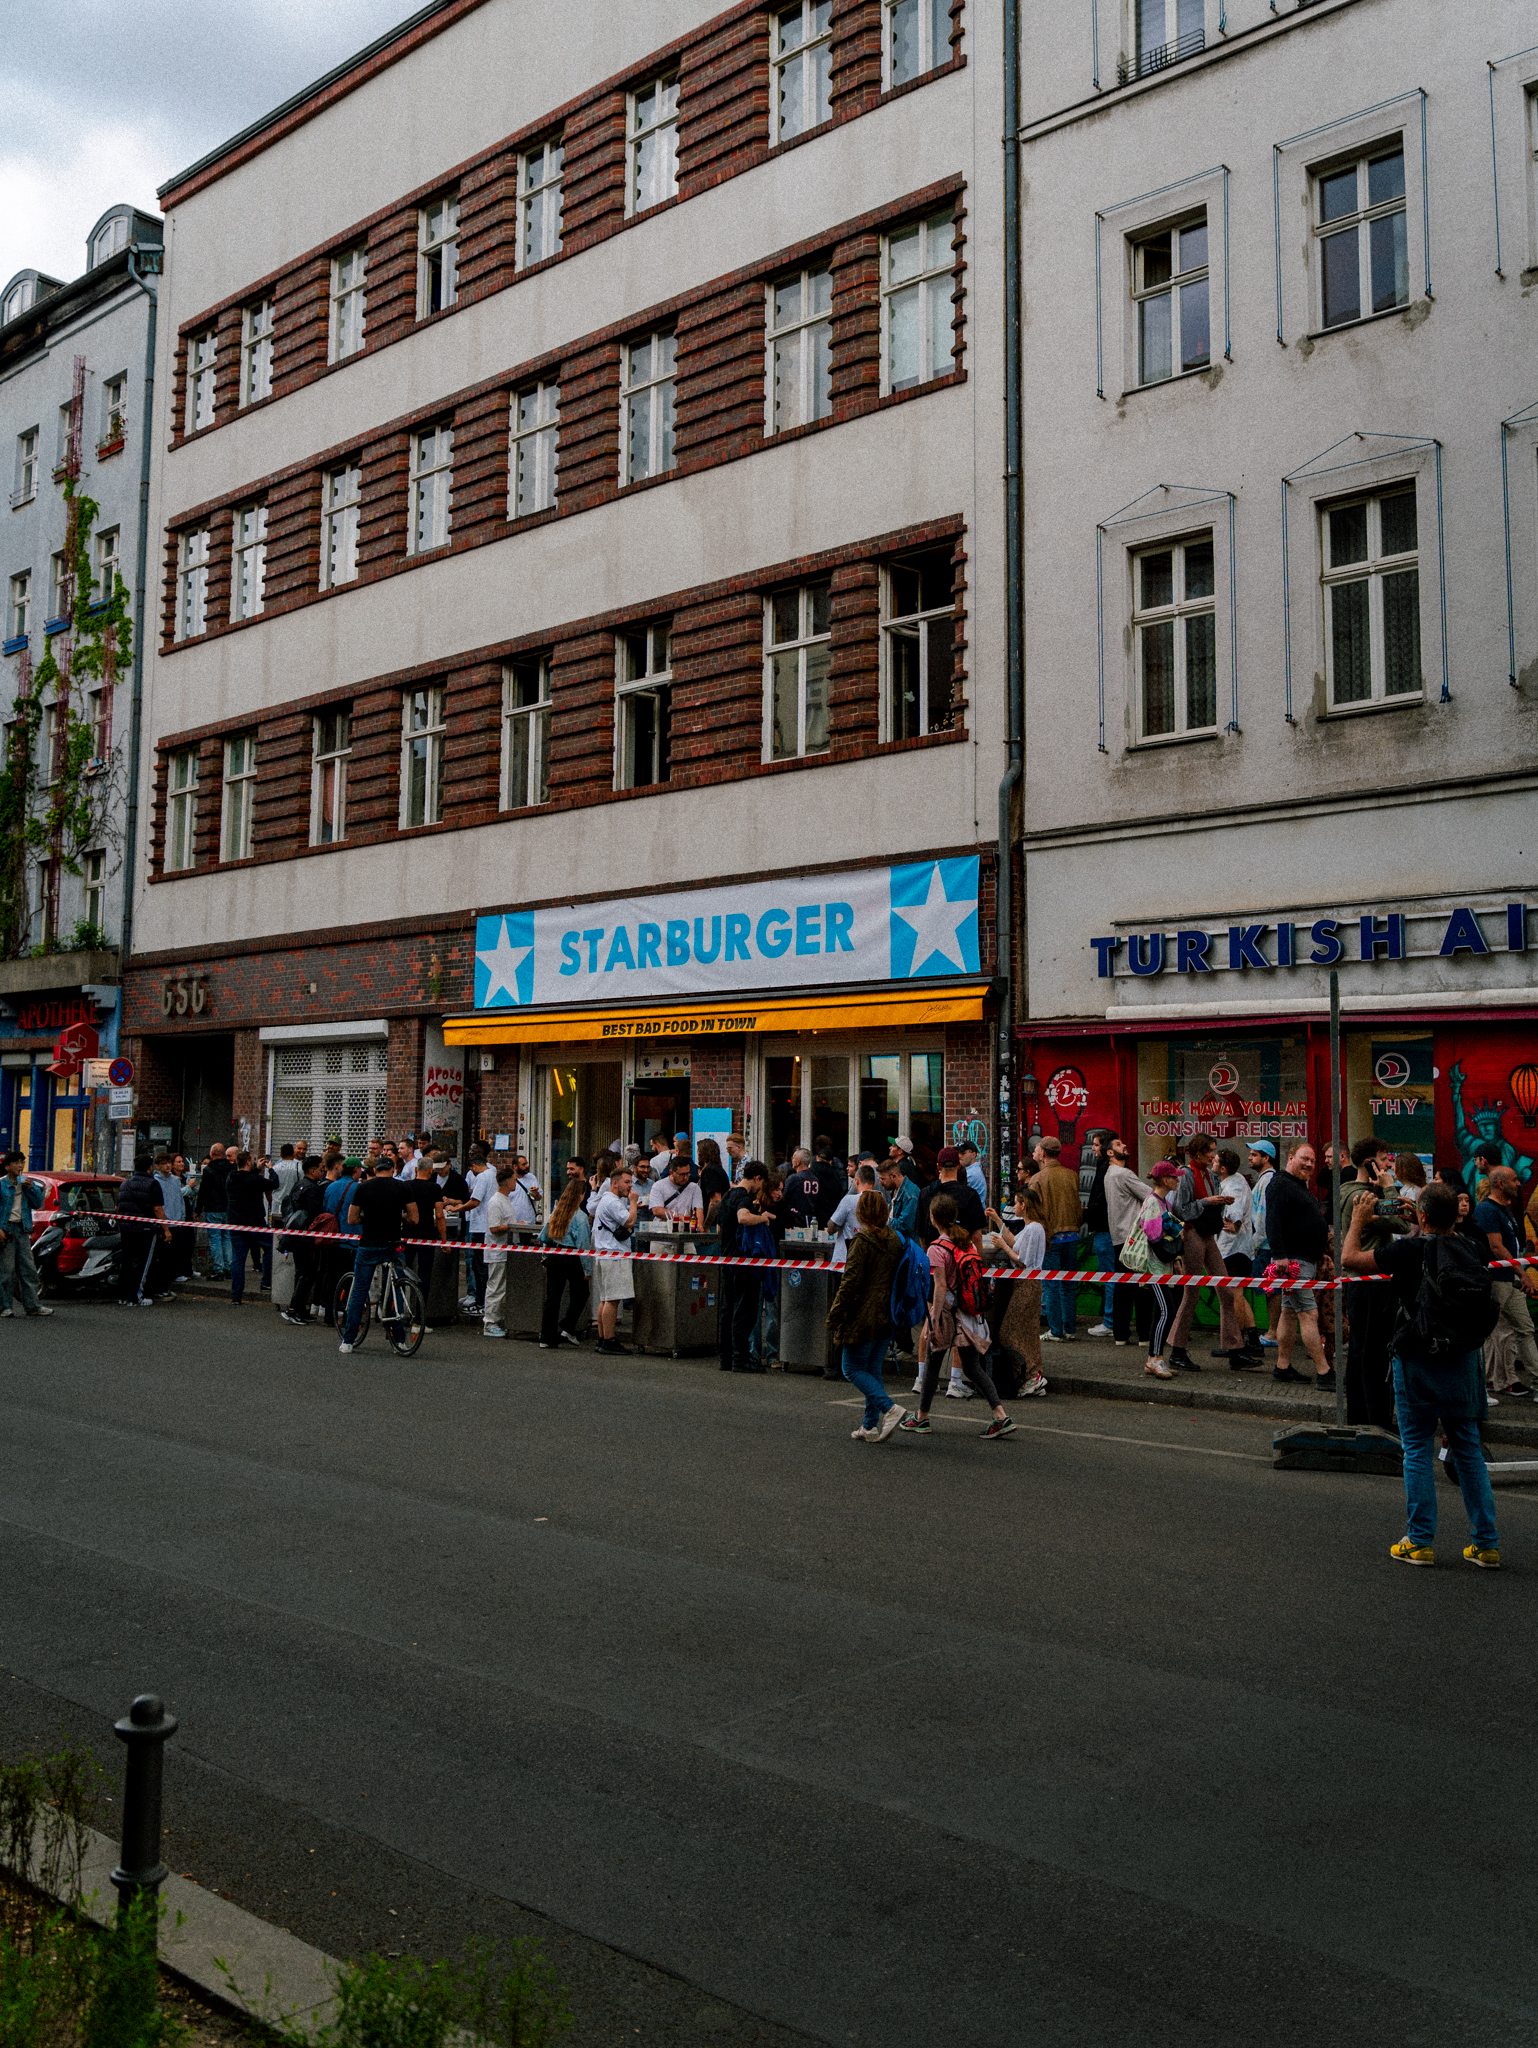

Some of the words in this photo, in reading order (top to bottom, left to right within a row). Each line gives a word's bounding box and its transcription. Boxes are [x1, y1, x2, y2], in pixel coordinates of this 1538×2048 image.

[559, 902, 855, 976] STARBURGER
[1090, 914, 1406, 978] TURKISH
[17, 999, 98, 1029] APOTHEKE
[602, 1023, 634, 1037] BEST
[635, 1021, 661, 1034] BAD
[663, 1019, 699, 1033] FOOD
[700, 1019, 716, 1031] IN
[717, 1017, 757, 1030] TOWN
[483, 1057, 489, 1067] 6
[1140, 1096, 1184, 1116] TÜRK
[1189, 1100, 1235, 1116] HAVA
[1369, 1098, 1419, 1115] THY
[1144, 1121, 1229, 1137] CONSULT
[1236, 1122, 1307, 1138] REISEN
[803, 1180, 819, 1194] 03
